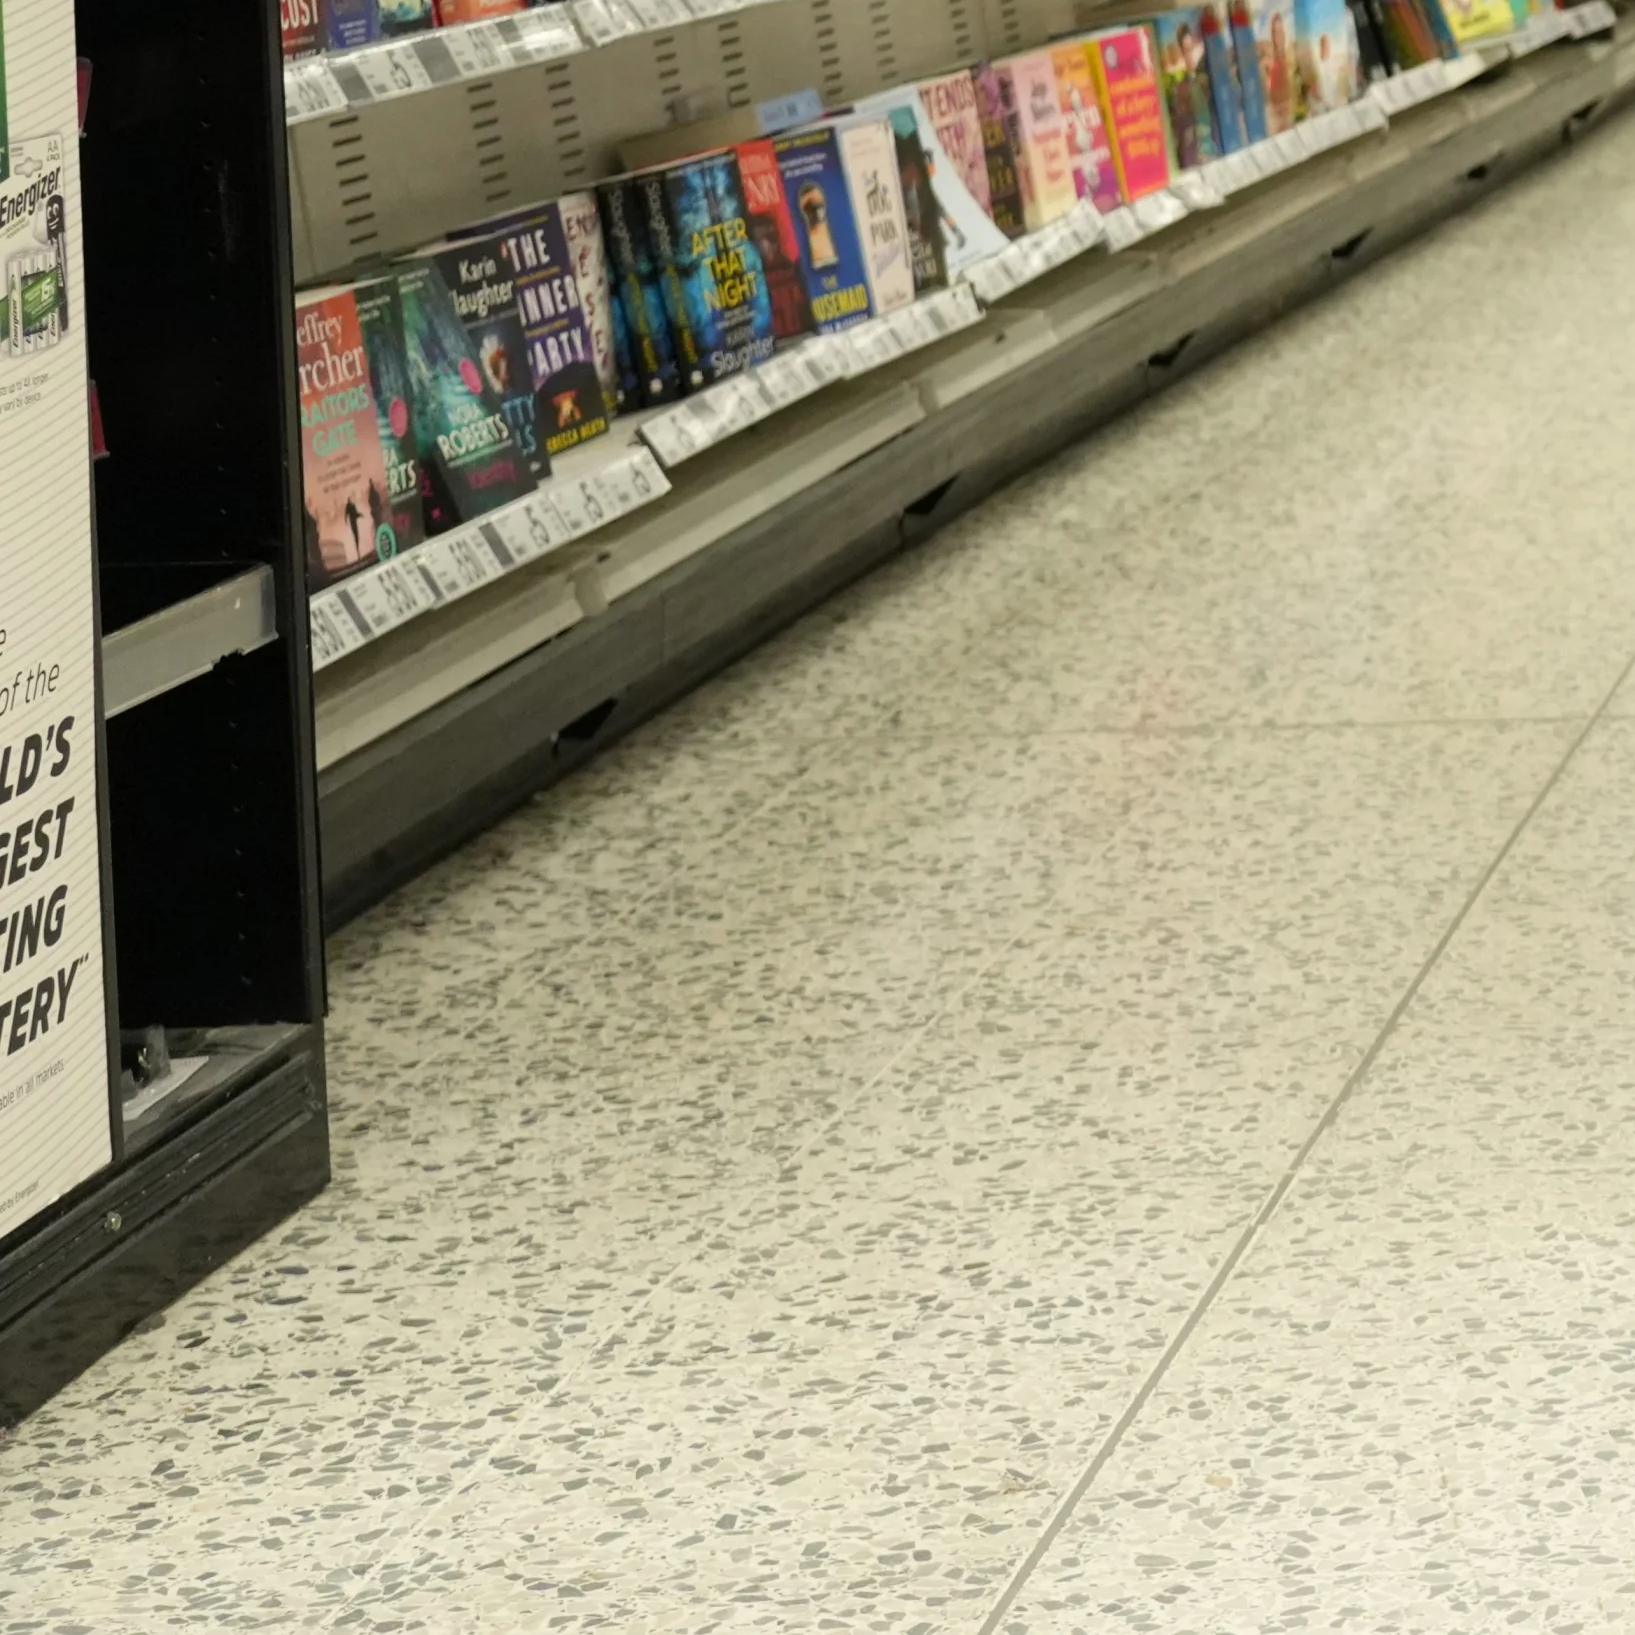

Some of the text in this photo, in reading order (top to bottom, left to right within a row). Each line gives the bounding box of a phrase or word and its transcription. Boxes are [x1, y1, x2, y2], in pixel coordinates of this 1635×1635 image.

[507, 229, 551, 272] THE
[691, 217, 748, 258] AFTER
[458, 256, 498, 286] Karin
[700, 247, 748, 283] THAT
[516, 272, 580, 329] INNER
[703, 270, 758, 316] NIGHT
[296, 311, 344, 350] effrey
[525, 325, 587, 379] ARTY
[298, 342, 365, 398] rcher
[299, 383, 371, 427] RAITORS
[311, 419, 358, 460] GATE
[436, 410, 509, 462] ROBERTS
[25, 662, 61, 705] the
